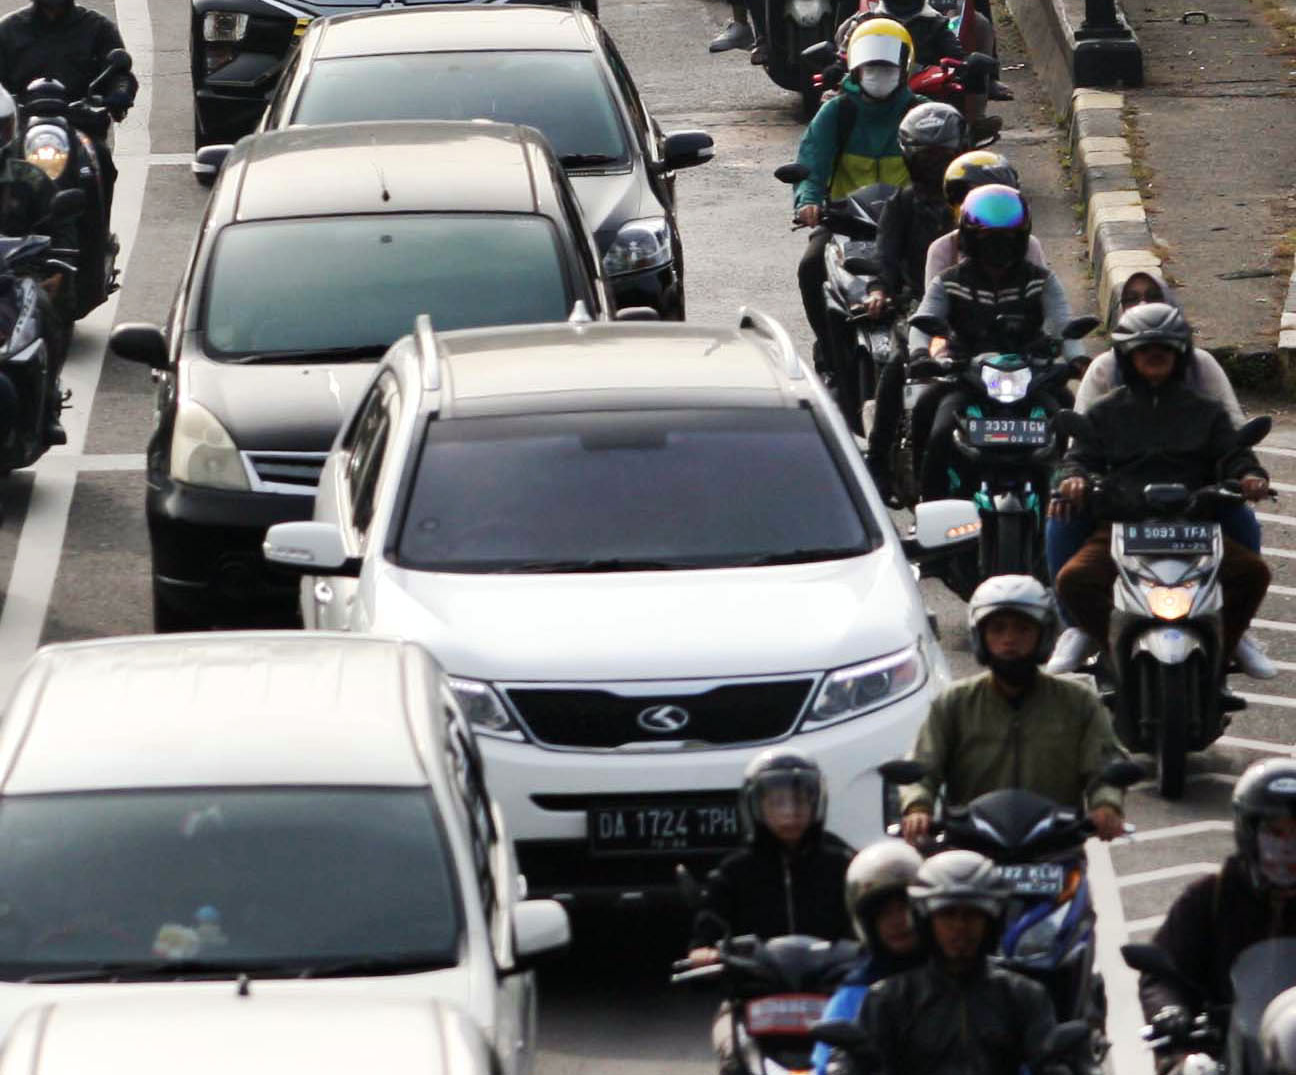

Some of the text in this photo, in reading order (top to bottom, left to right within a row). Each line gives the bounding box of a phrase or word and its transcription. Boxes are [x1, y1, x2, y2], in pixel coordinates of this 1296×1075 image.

[969, 421, 977, 432] B
[1184, 526, 1207, 538] TFA
[599, 808, 737, 839] DA 1724 TPH
